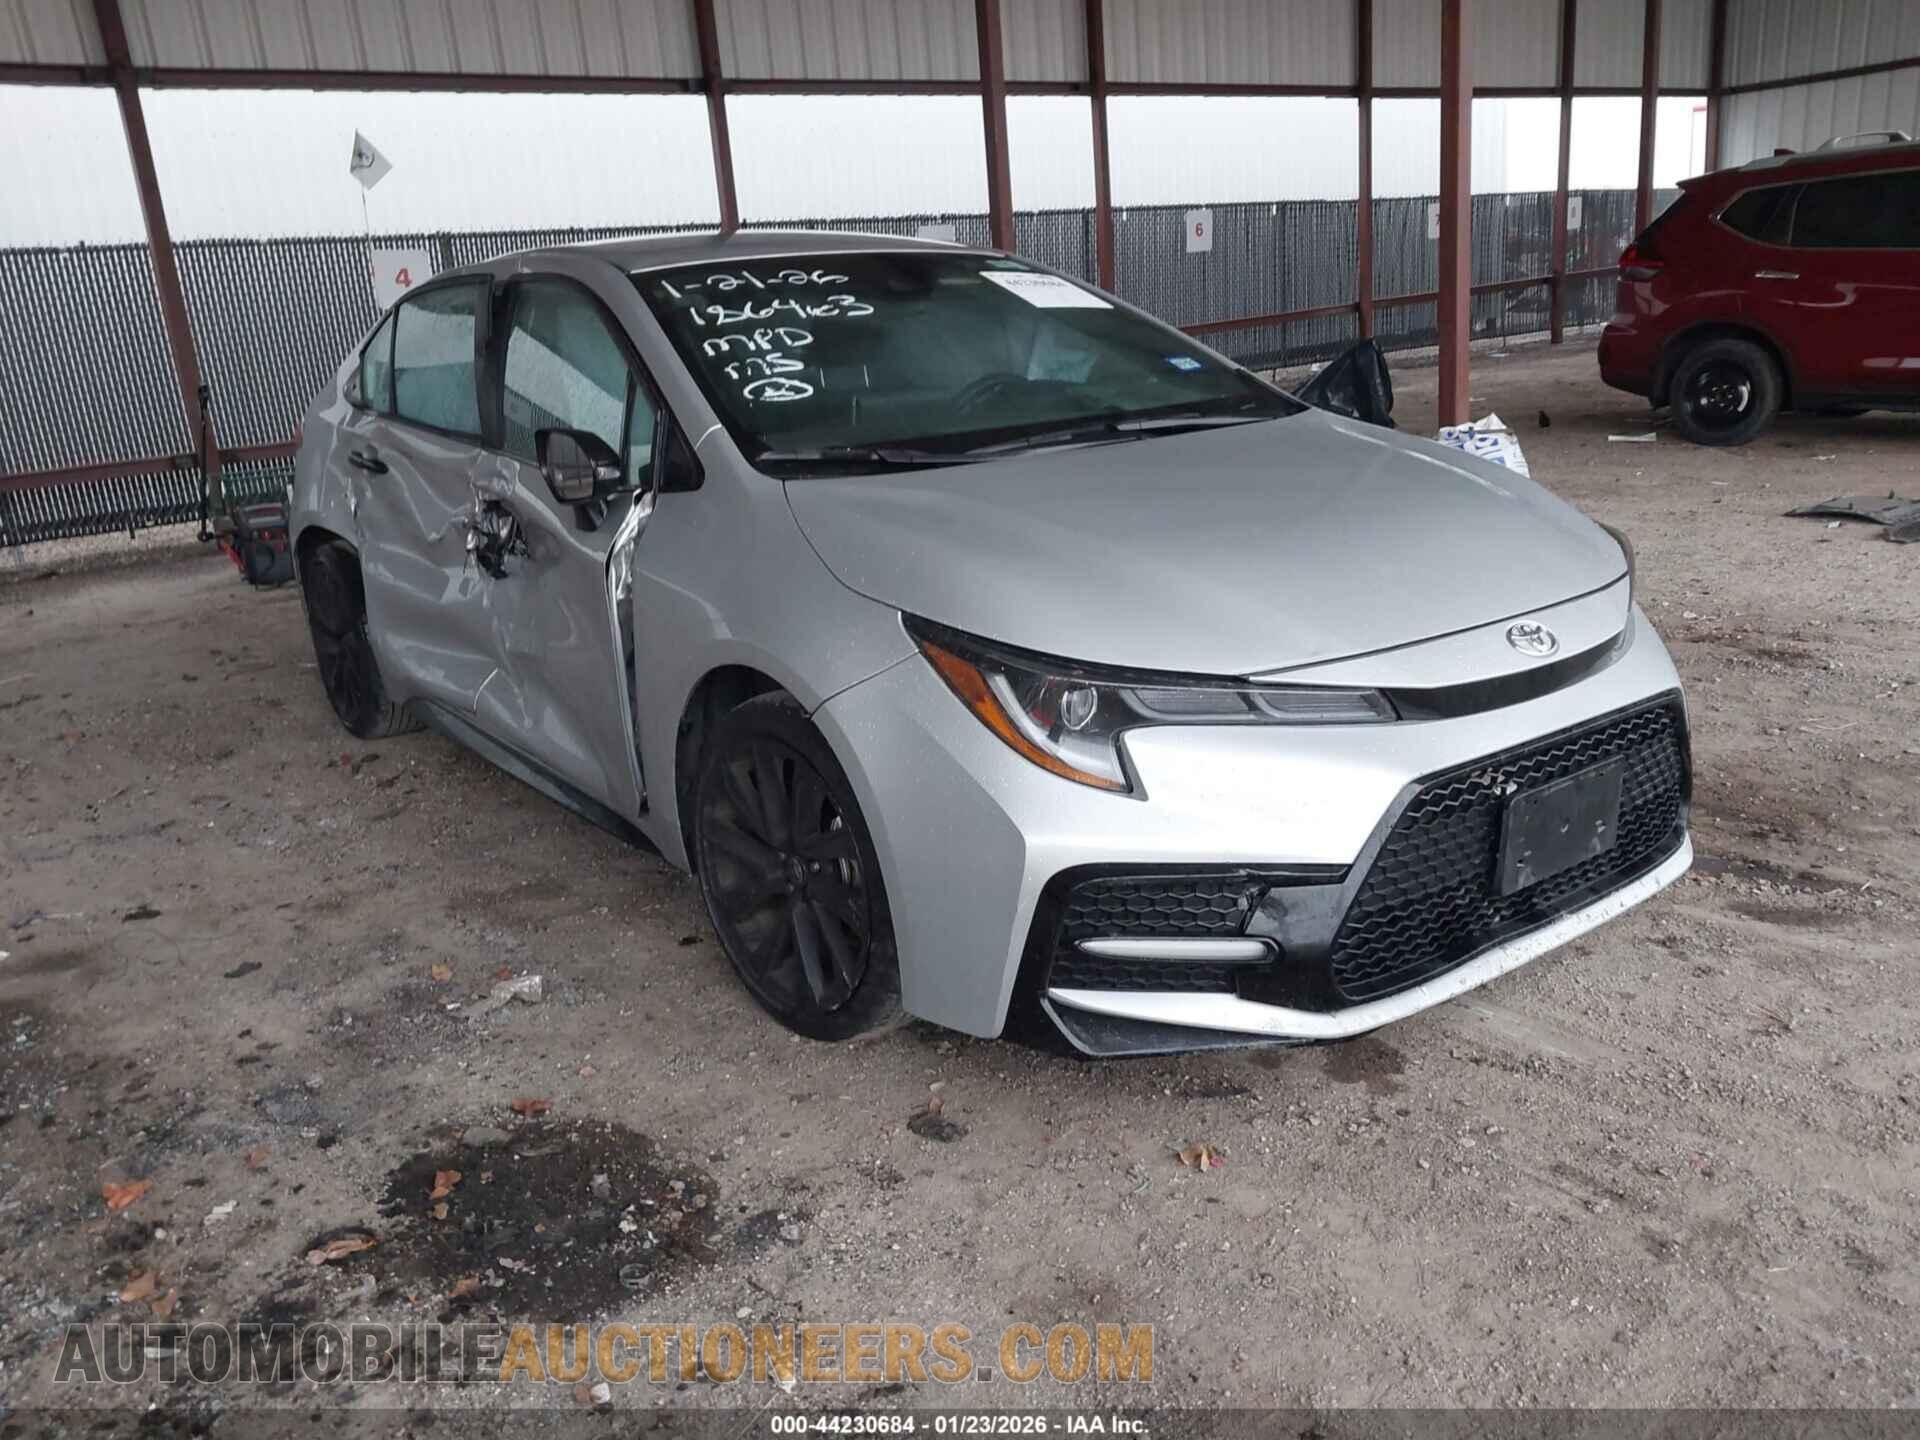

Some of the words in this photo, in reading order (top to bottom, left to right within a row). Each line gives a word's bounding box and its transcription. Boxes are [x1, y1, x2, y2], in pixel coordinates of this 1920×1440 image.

[1195, 222, 1204, 237] 6
[395, 268, 412, 288] 4
[661, 269, 849, 298] 1-21-26
